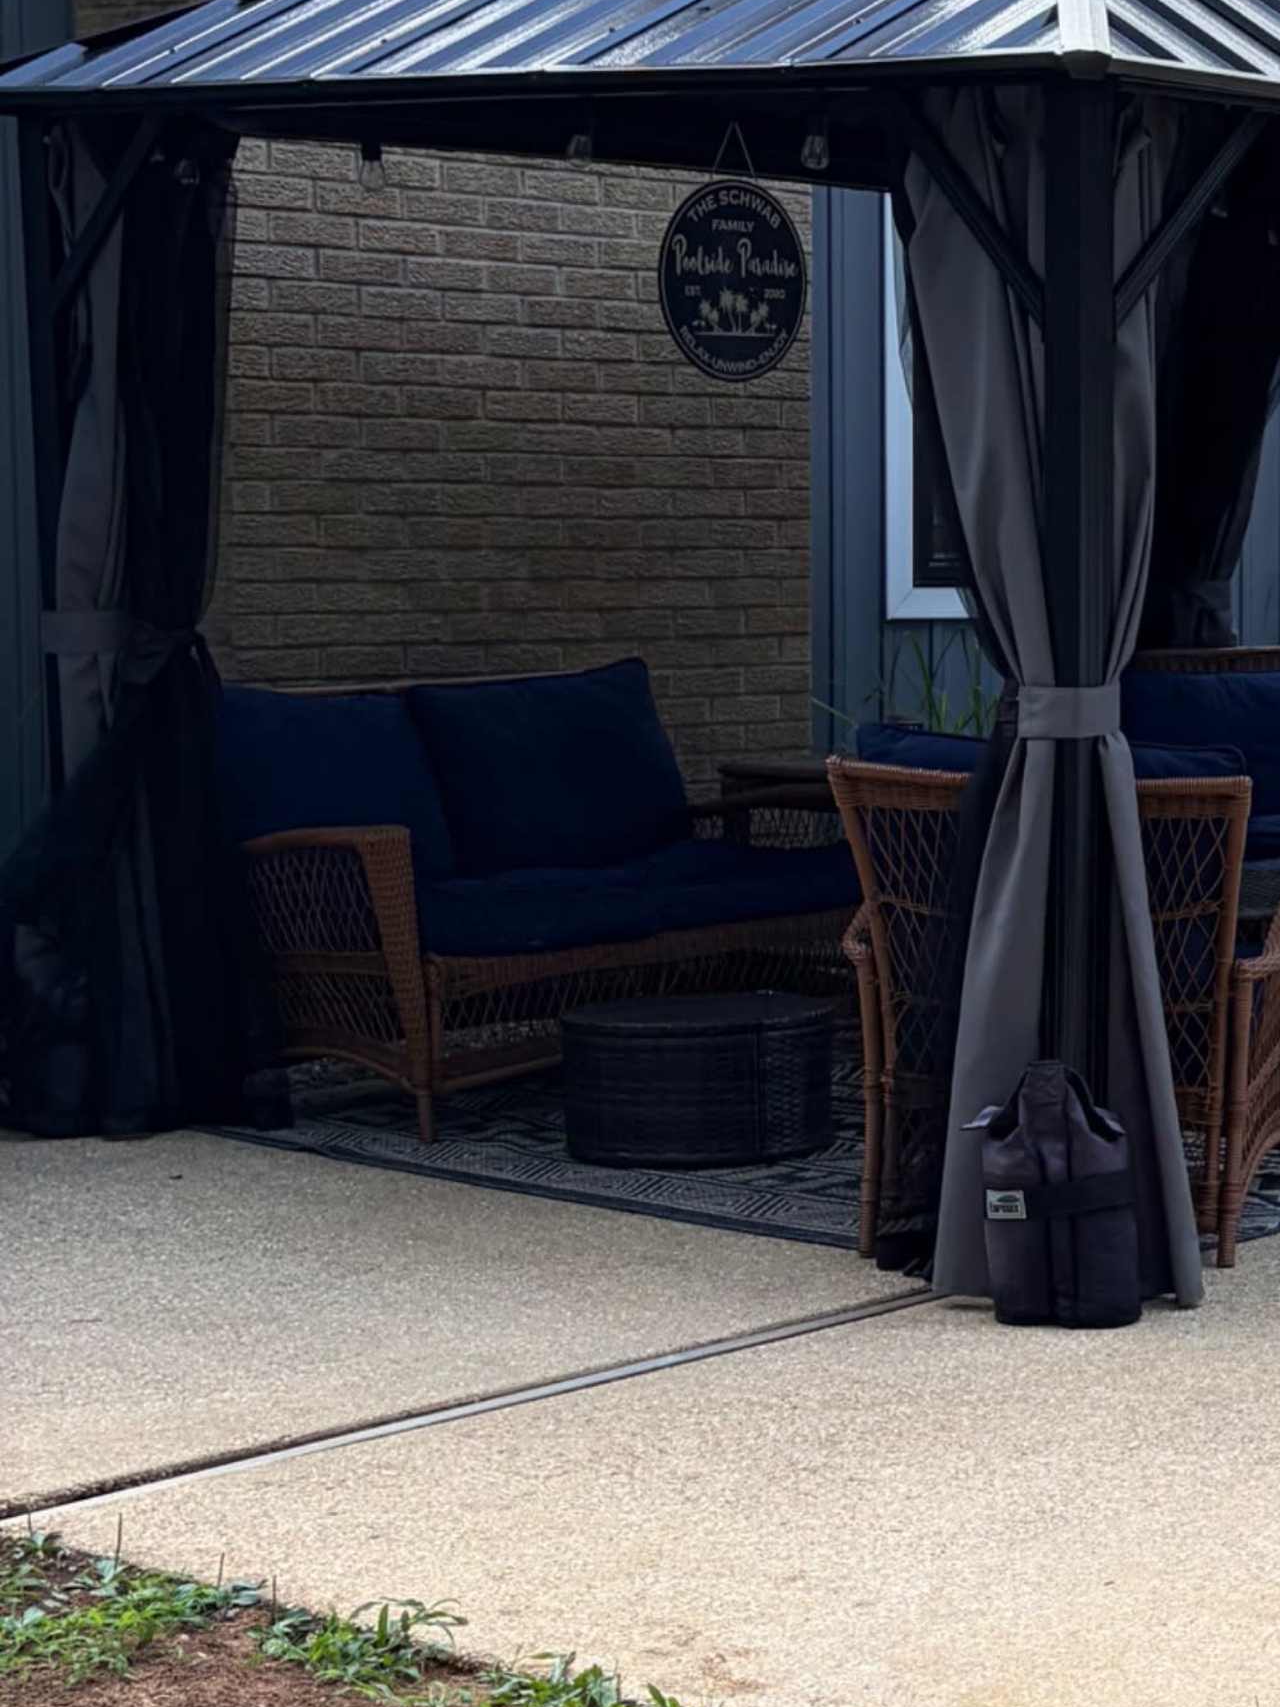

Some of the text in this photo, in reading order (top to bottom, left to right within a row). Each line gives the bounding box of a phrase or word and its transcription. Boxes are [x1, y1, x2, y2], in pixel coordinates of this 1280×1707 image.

[687, 190, 781, 229] THE SCHWAB
[712, 219, 755, 232] FAMILY
[672, 234, 798, 278] Poolside Paradise
